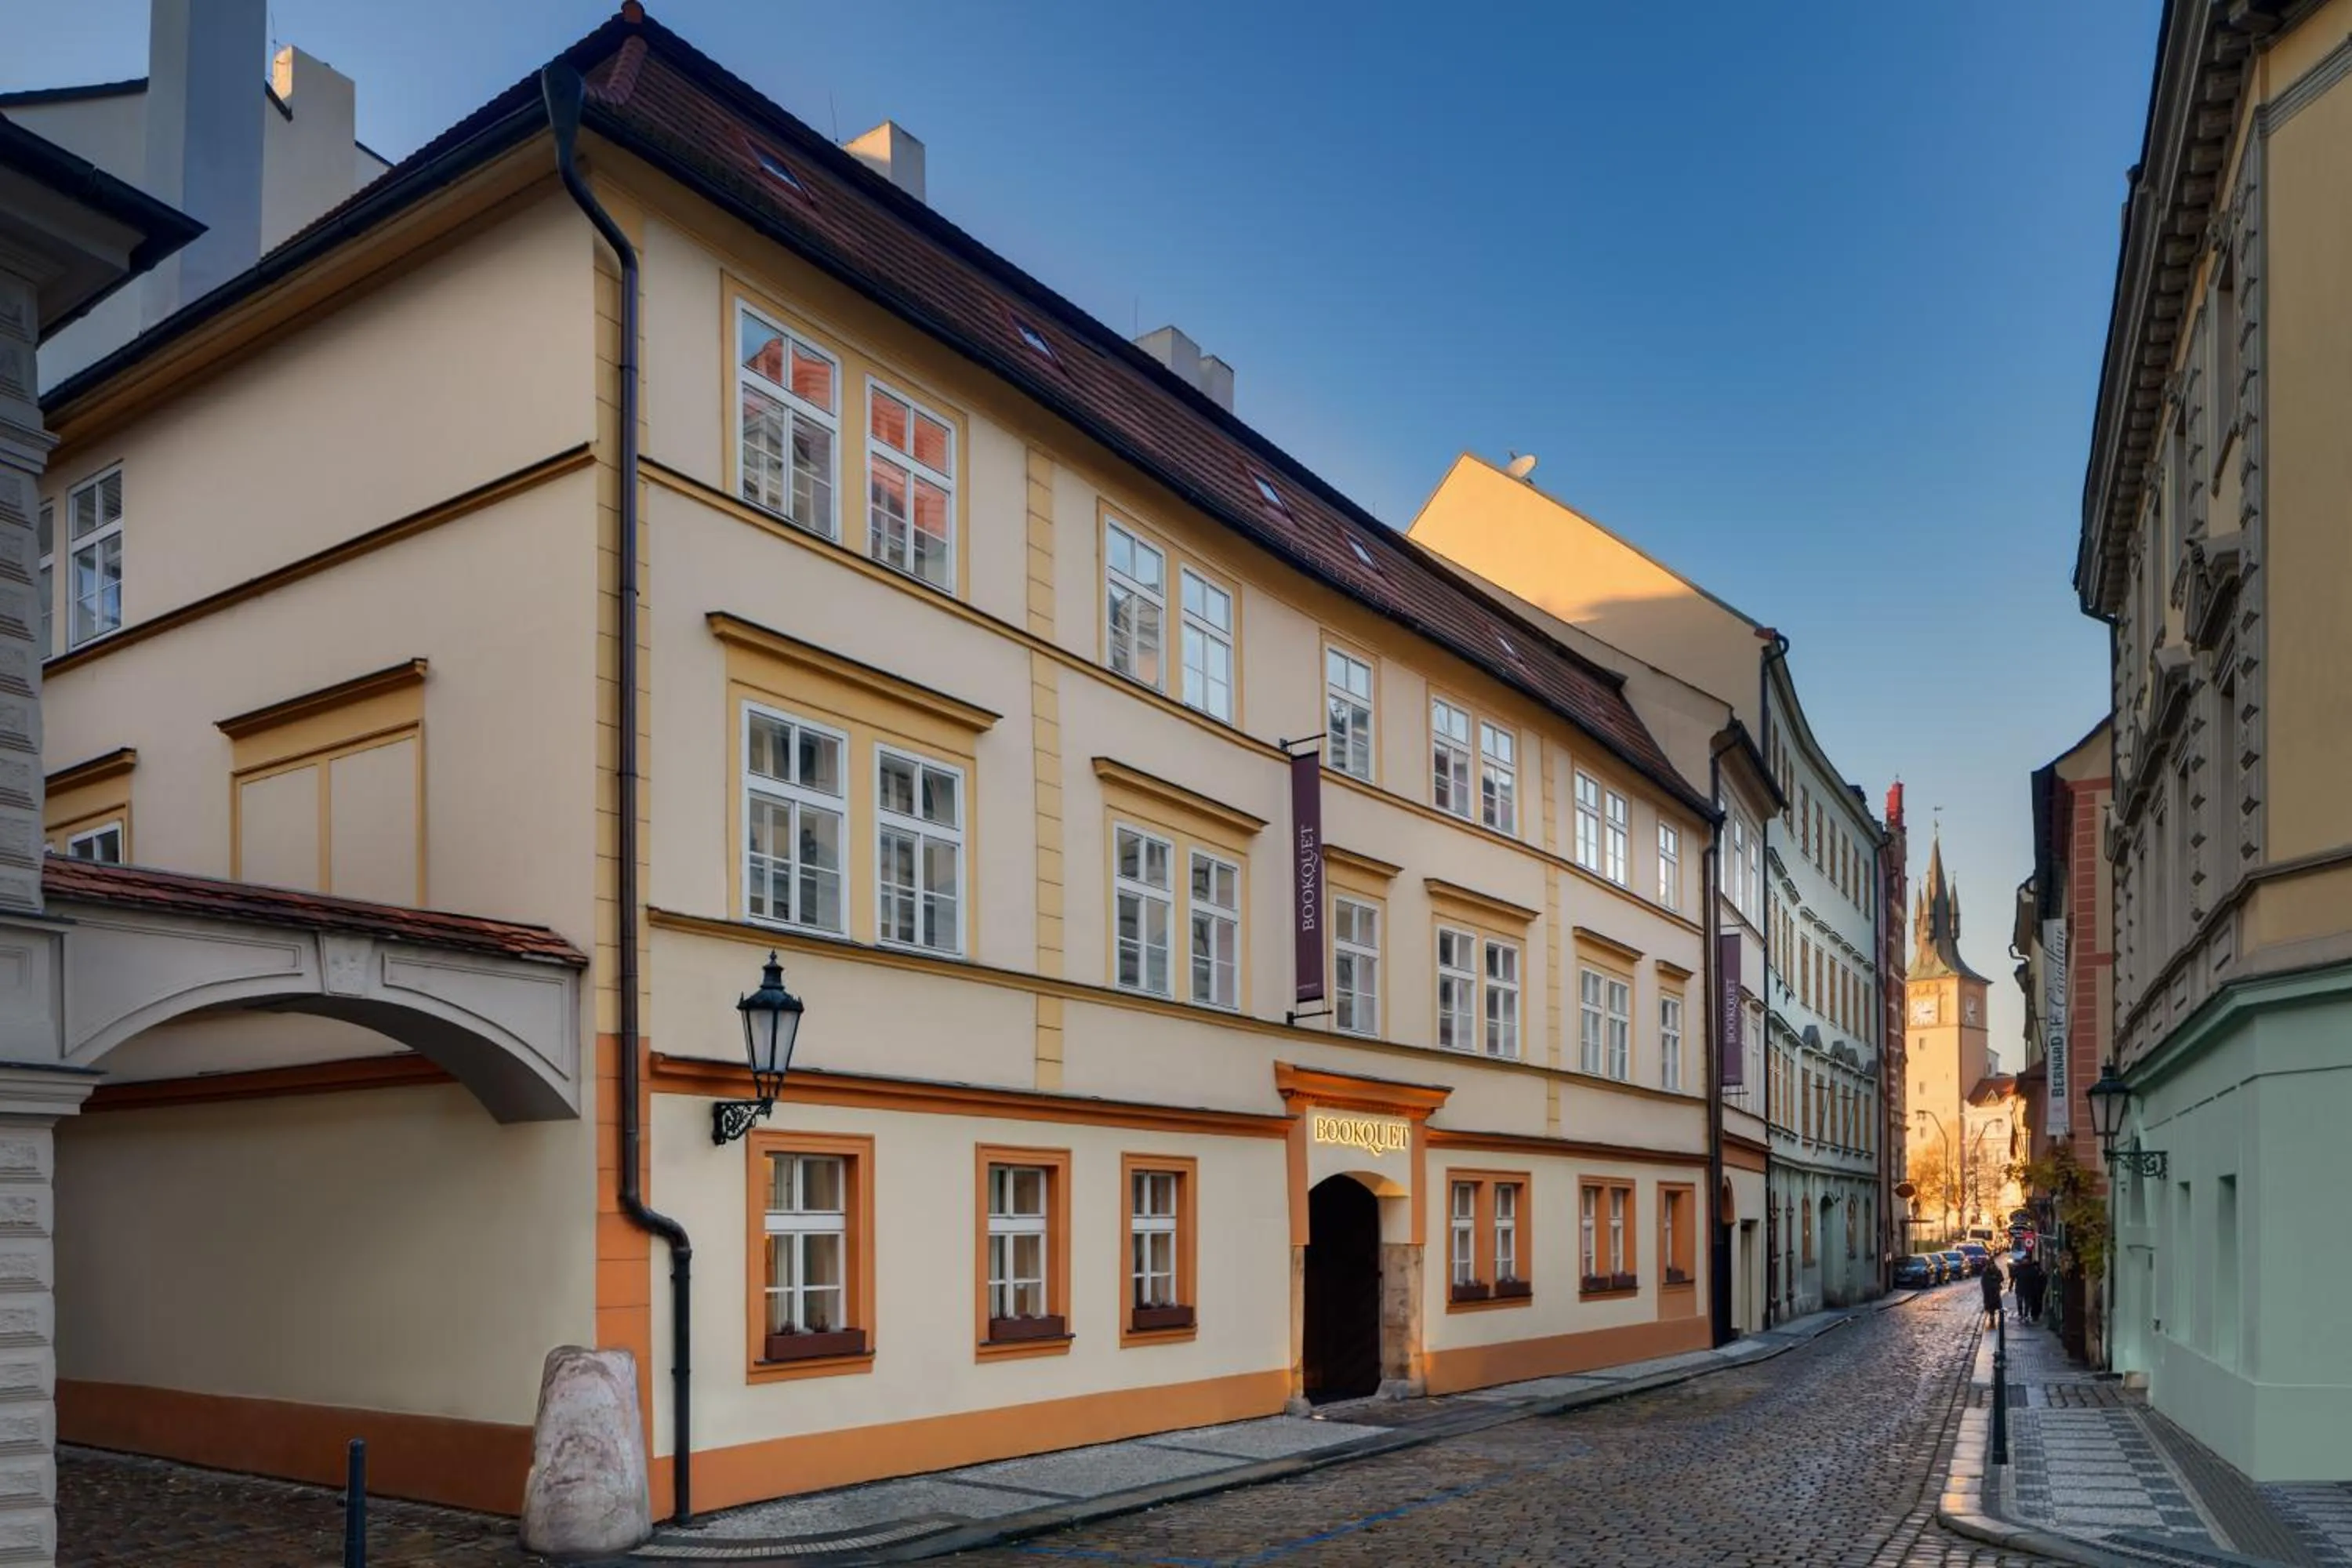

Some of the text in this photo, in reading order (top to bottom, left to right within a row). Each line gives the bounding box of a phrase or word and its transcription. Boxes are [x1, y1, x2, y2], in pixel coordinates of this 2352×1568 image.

[1301, 827, 1318, 931] BOOKQUET
[1726, 978, 1739, 1043] BOOKQUET
[2050, 1036, 2064, 1098] BERNARD
[1316, 1117, 1410, 1154] BOOKQUET
